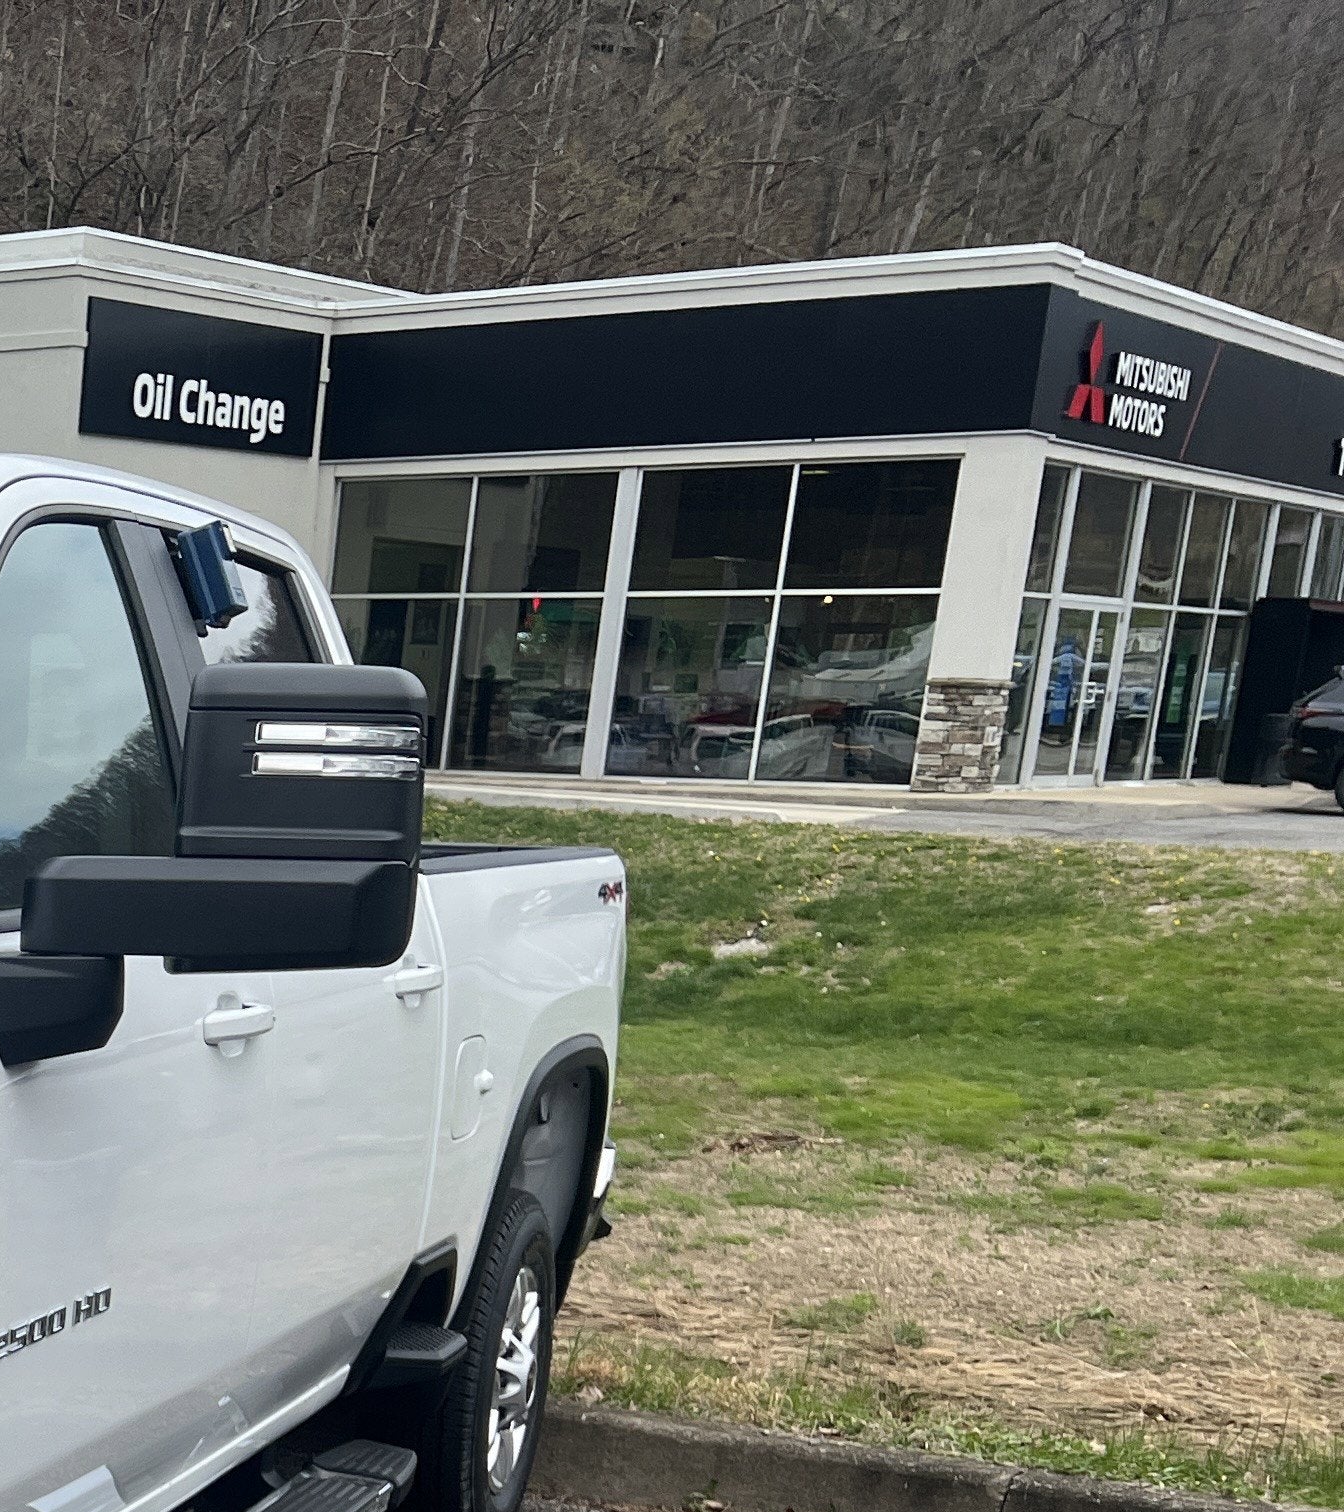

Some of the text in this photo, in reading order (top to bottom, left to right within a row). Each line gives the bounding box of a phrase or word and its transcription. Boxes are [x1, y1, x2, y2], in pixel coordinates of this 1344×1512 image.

[1115, 351, 1191, 401] MITSUBISHI
[133, 372, 285, 443] Oil Change
[1108, 393, 1166, 437] MOTORS
[72, 1283, 112, 1327] HD
